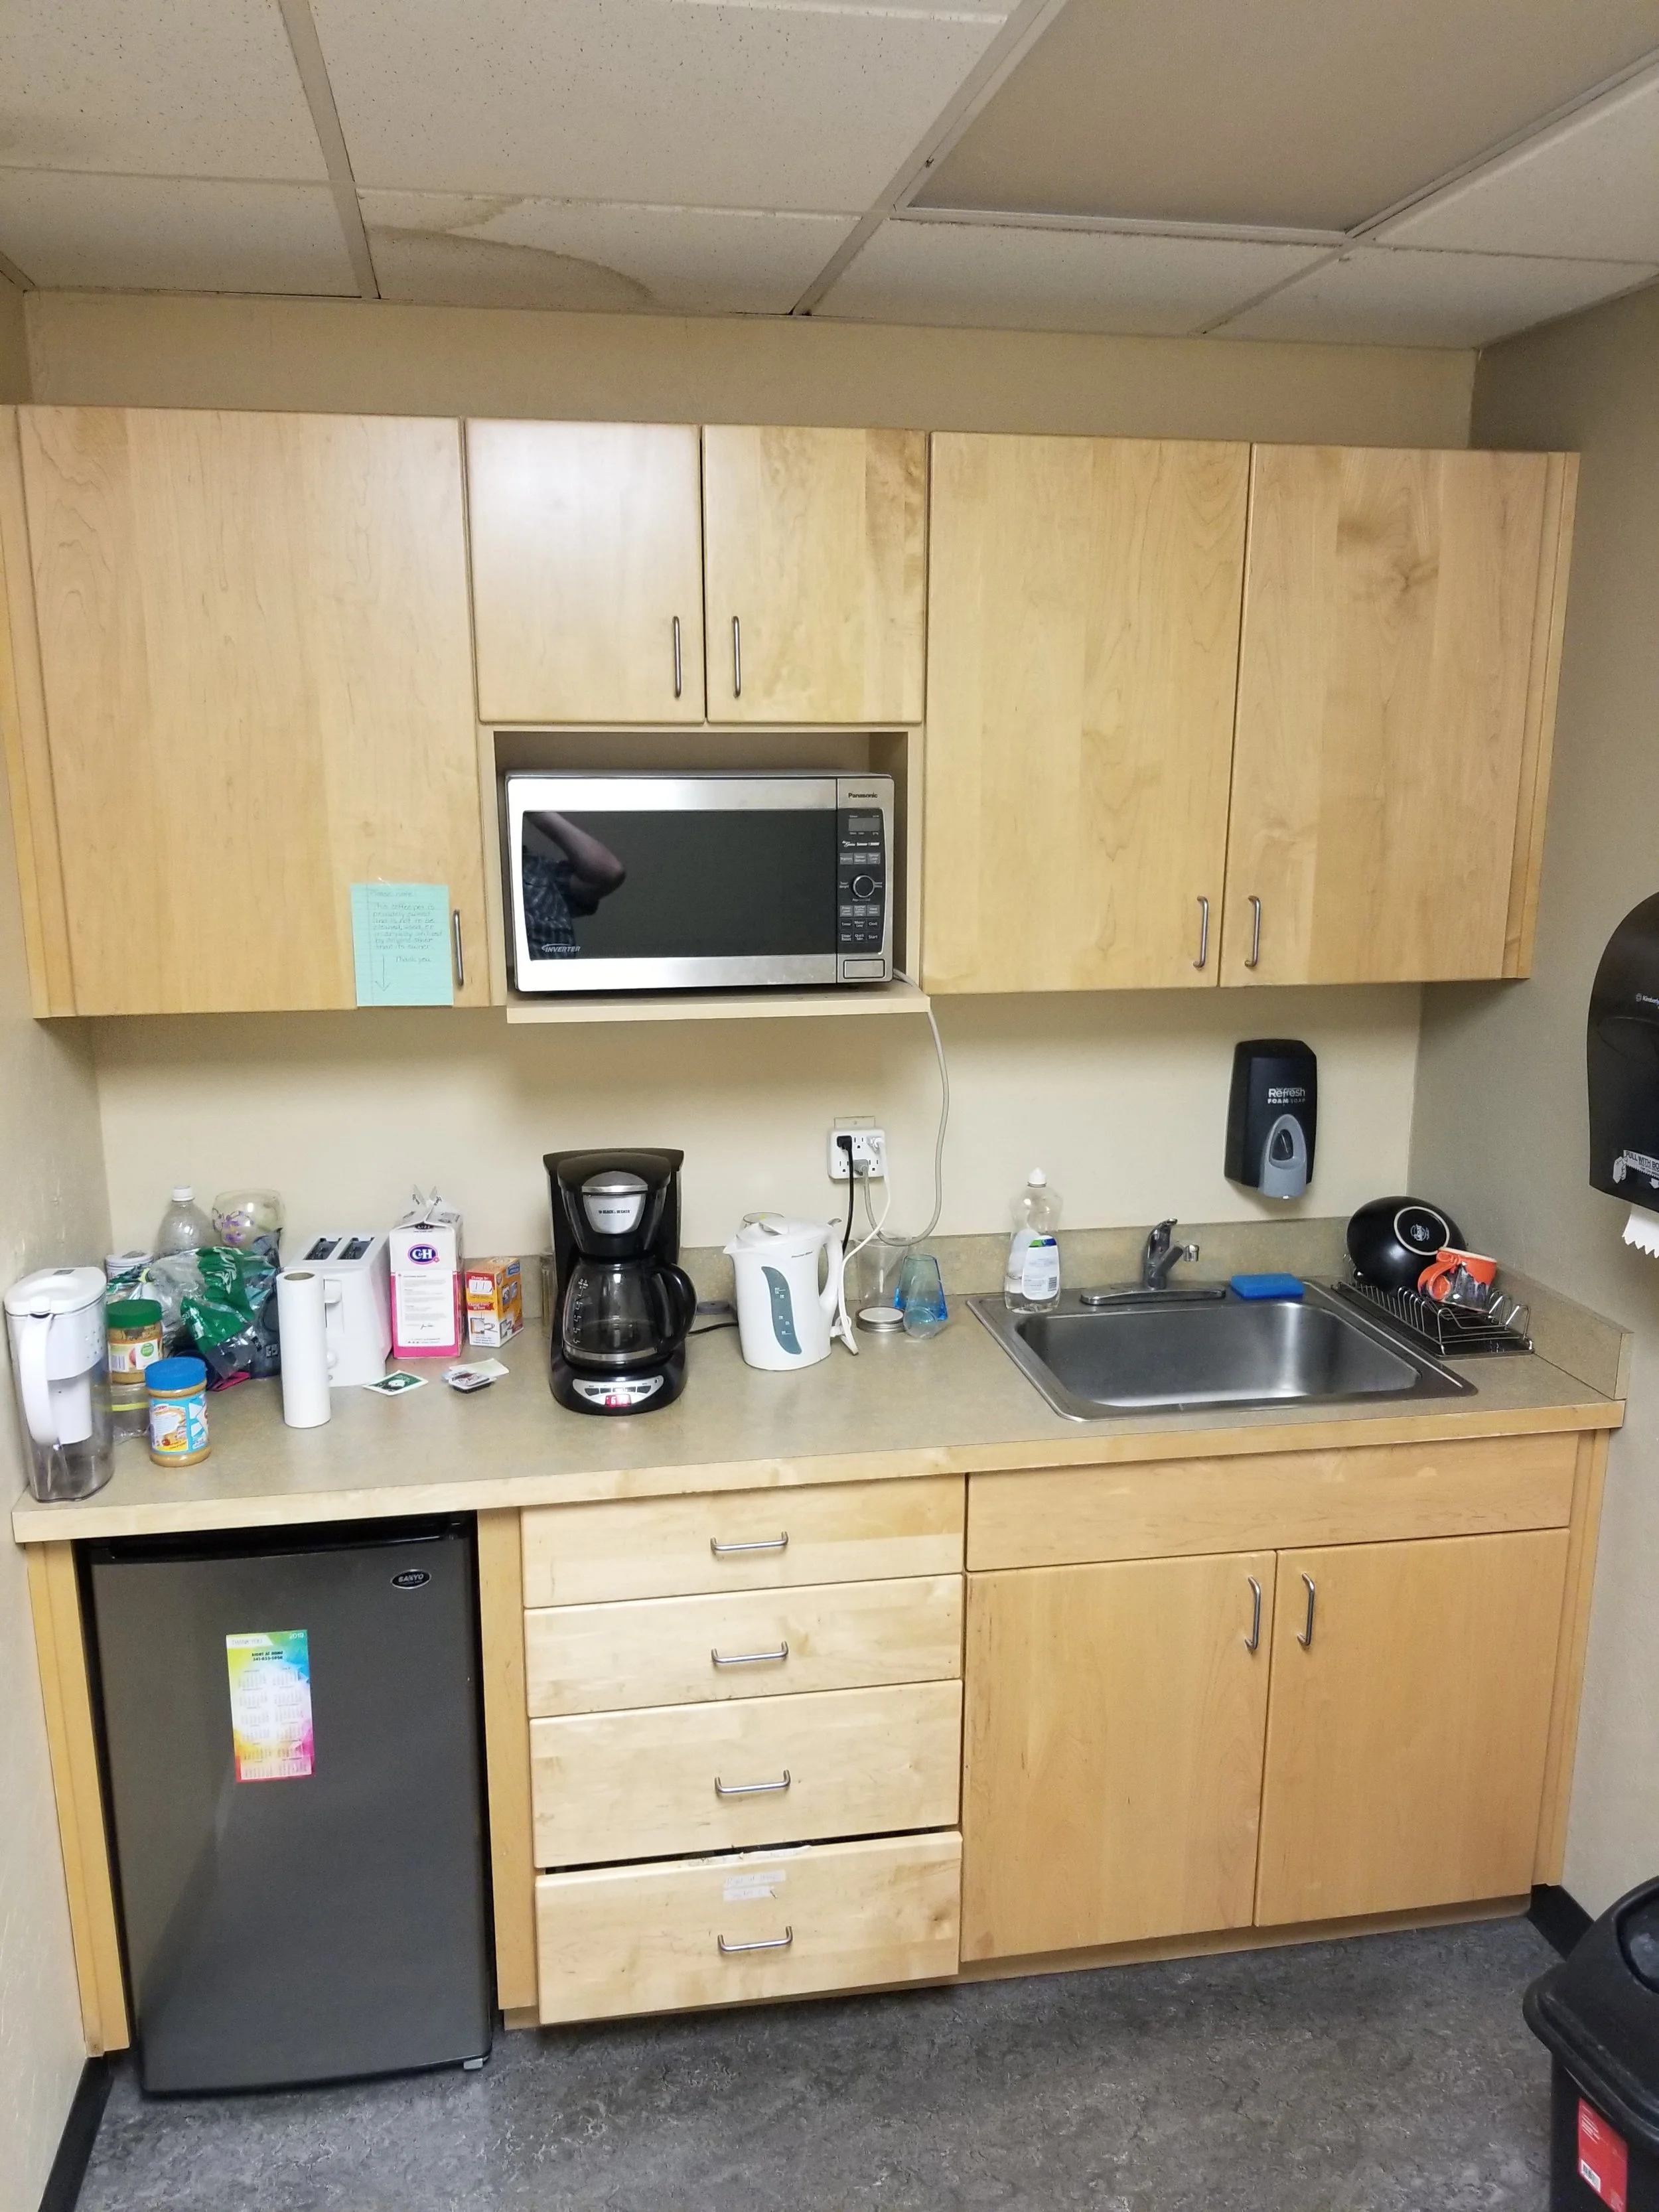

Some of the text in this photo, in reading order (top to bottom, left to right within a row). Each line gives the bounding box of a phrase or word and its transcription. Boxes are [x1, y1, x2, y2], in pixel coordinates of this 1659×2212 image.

[1268, 1087, 1306, 1098] Refresh
[1626, 1150, 1638, 1162] PULL
[1638, 1155, 1652, 1169] WITH
[398, 1573, 424, 1583] SANYO
